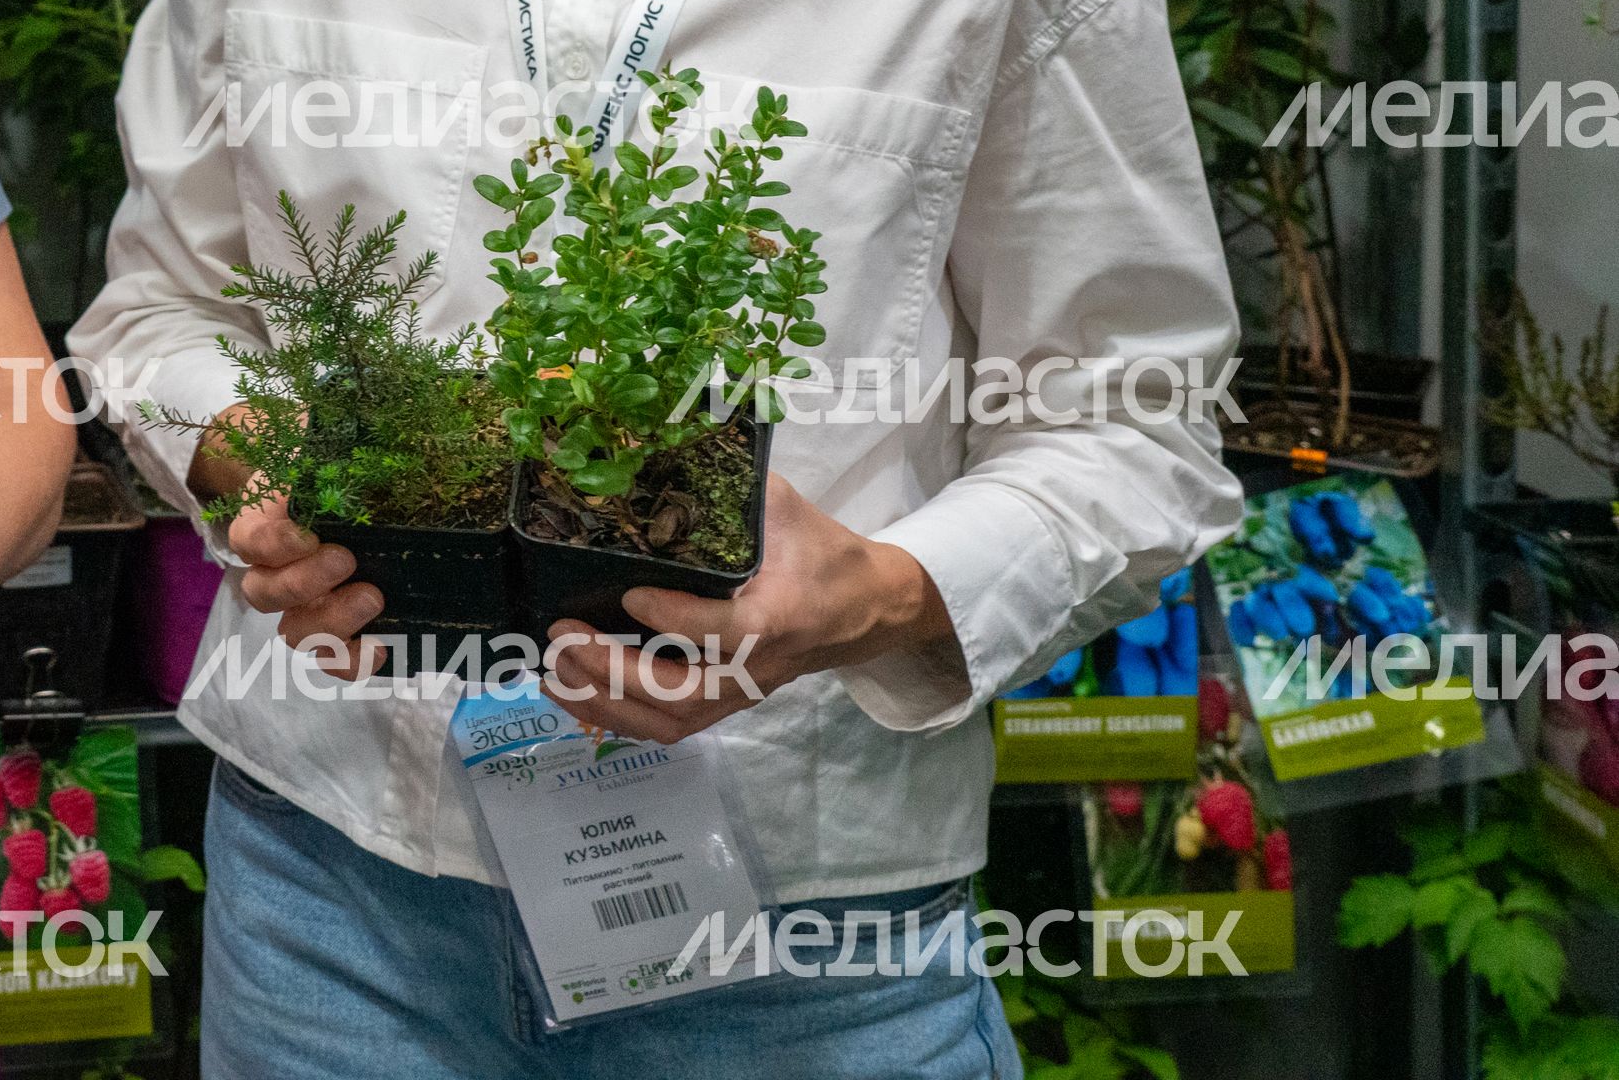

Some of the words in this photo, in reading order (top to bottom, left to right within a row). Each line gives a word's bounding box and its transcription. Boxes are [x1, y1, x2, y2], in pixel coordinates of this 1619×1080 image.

[592, 73, 632, 153] ФЛЕКС
[470, 713, 559, 751] ЭКСПО
[556, 748, 670, 787] УЧАСТНИК
[597, 772, 655, 792] Exhibitor
[580, 815, 636, 839] ЮЛИЯ
[564, 830, 667, 865] КУЗЬМИНА
[563, 867, 623, 886] Питомкино
[632, 852, 684, 871] питомник
[603, 871, 653, 892] растений
